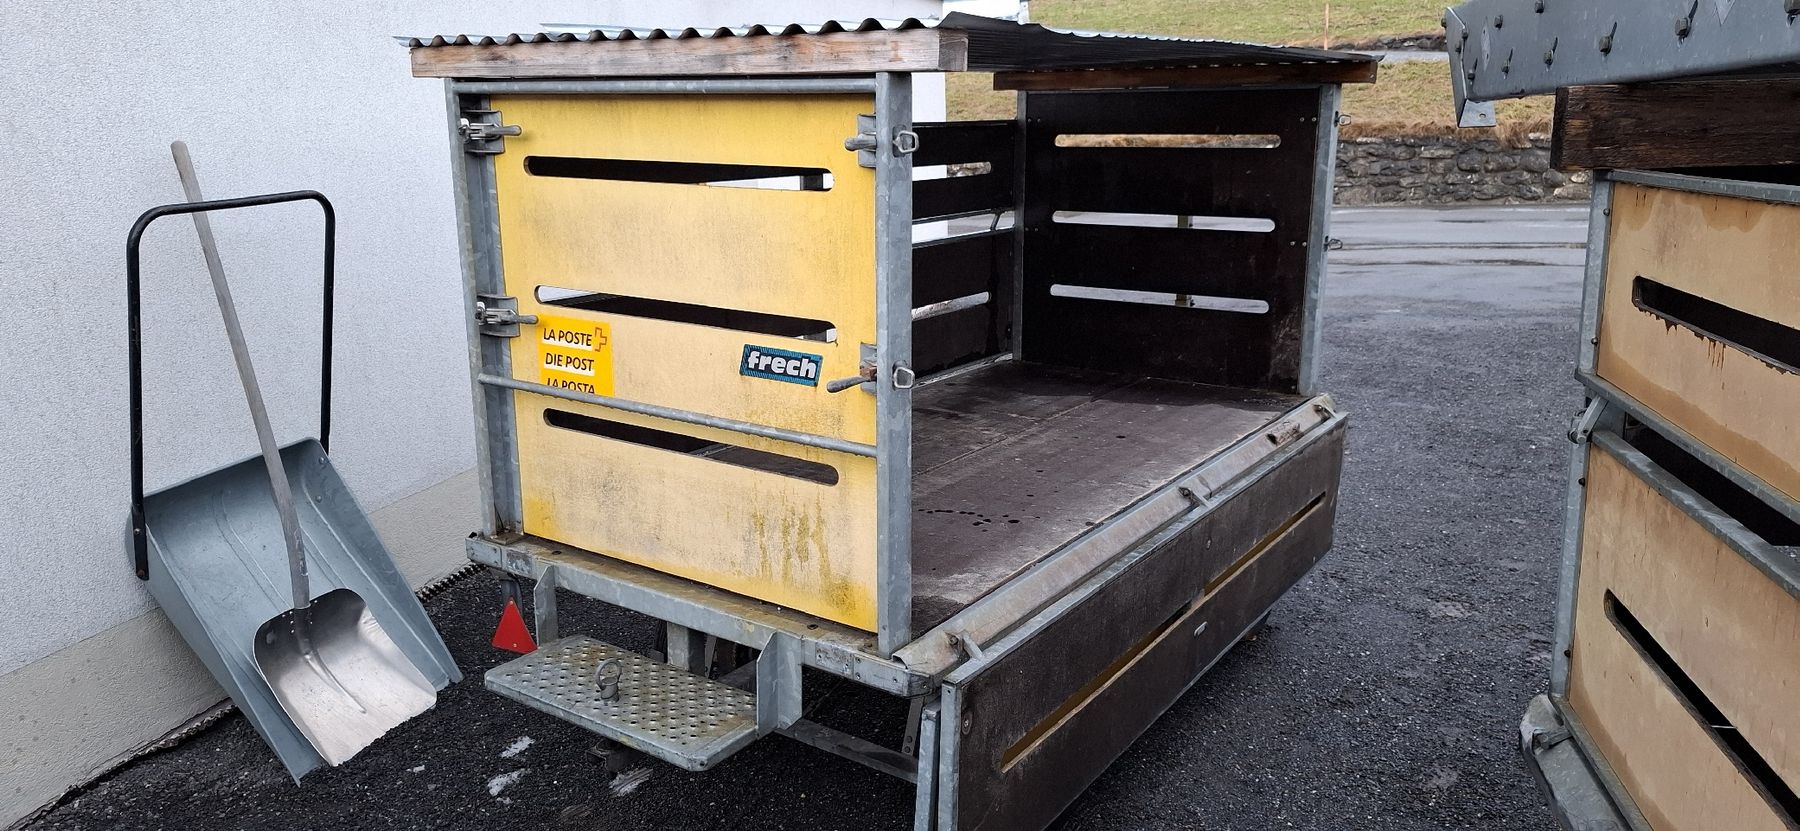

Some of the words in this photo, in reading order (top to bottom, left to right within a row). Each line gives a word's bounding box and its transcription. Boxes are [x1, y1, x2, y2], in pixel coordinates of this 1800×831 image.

[543, 328, 556, 341] LA
[558, 330, 593, 347] POSTE
[545, 352, 564, 367] DIE
[565, 355, 595, 372] POST
[747, 350, 817, 379] frech
